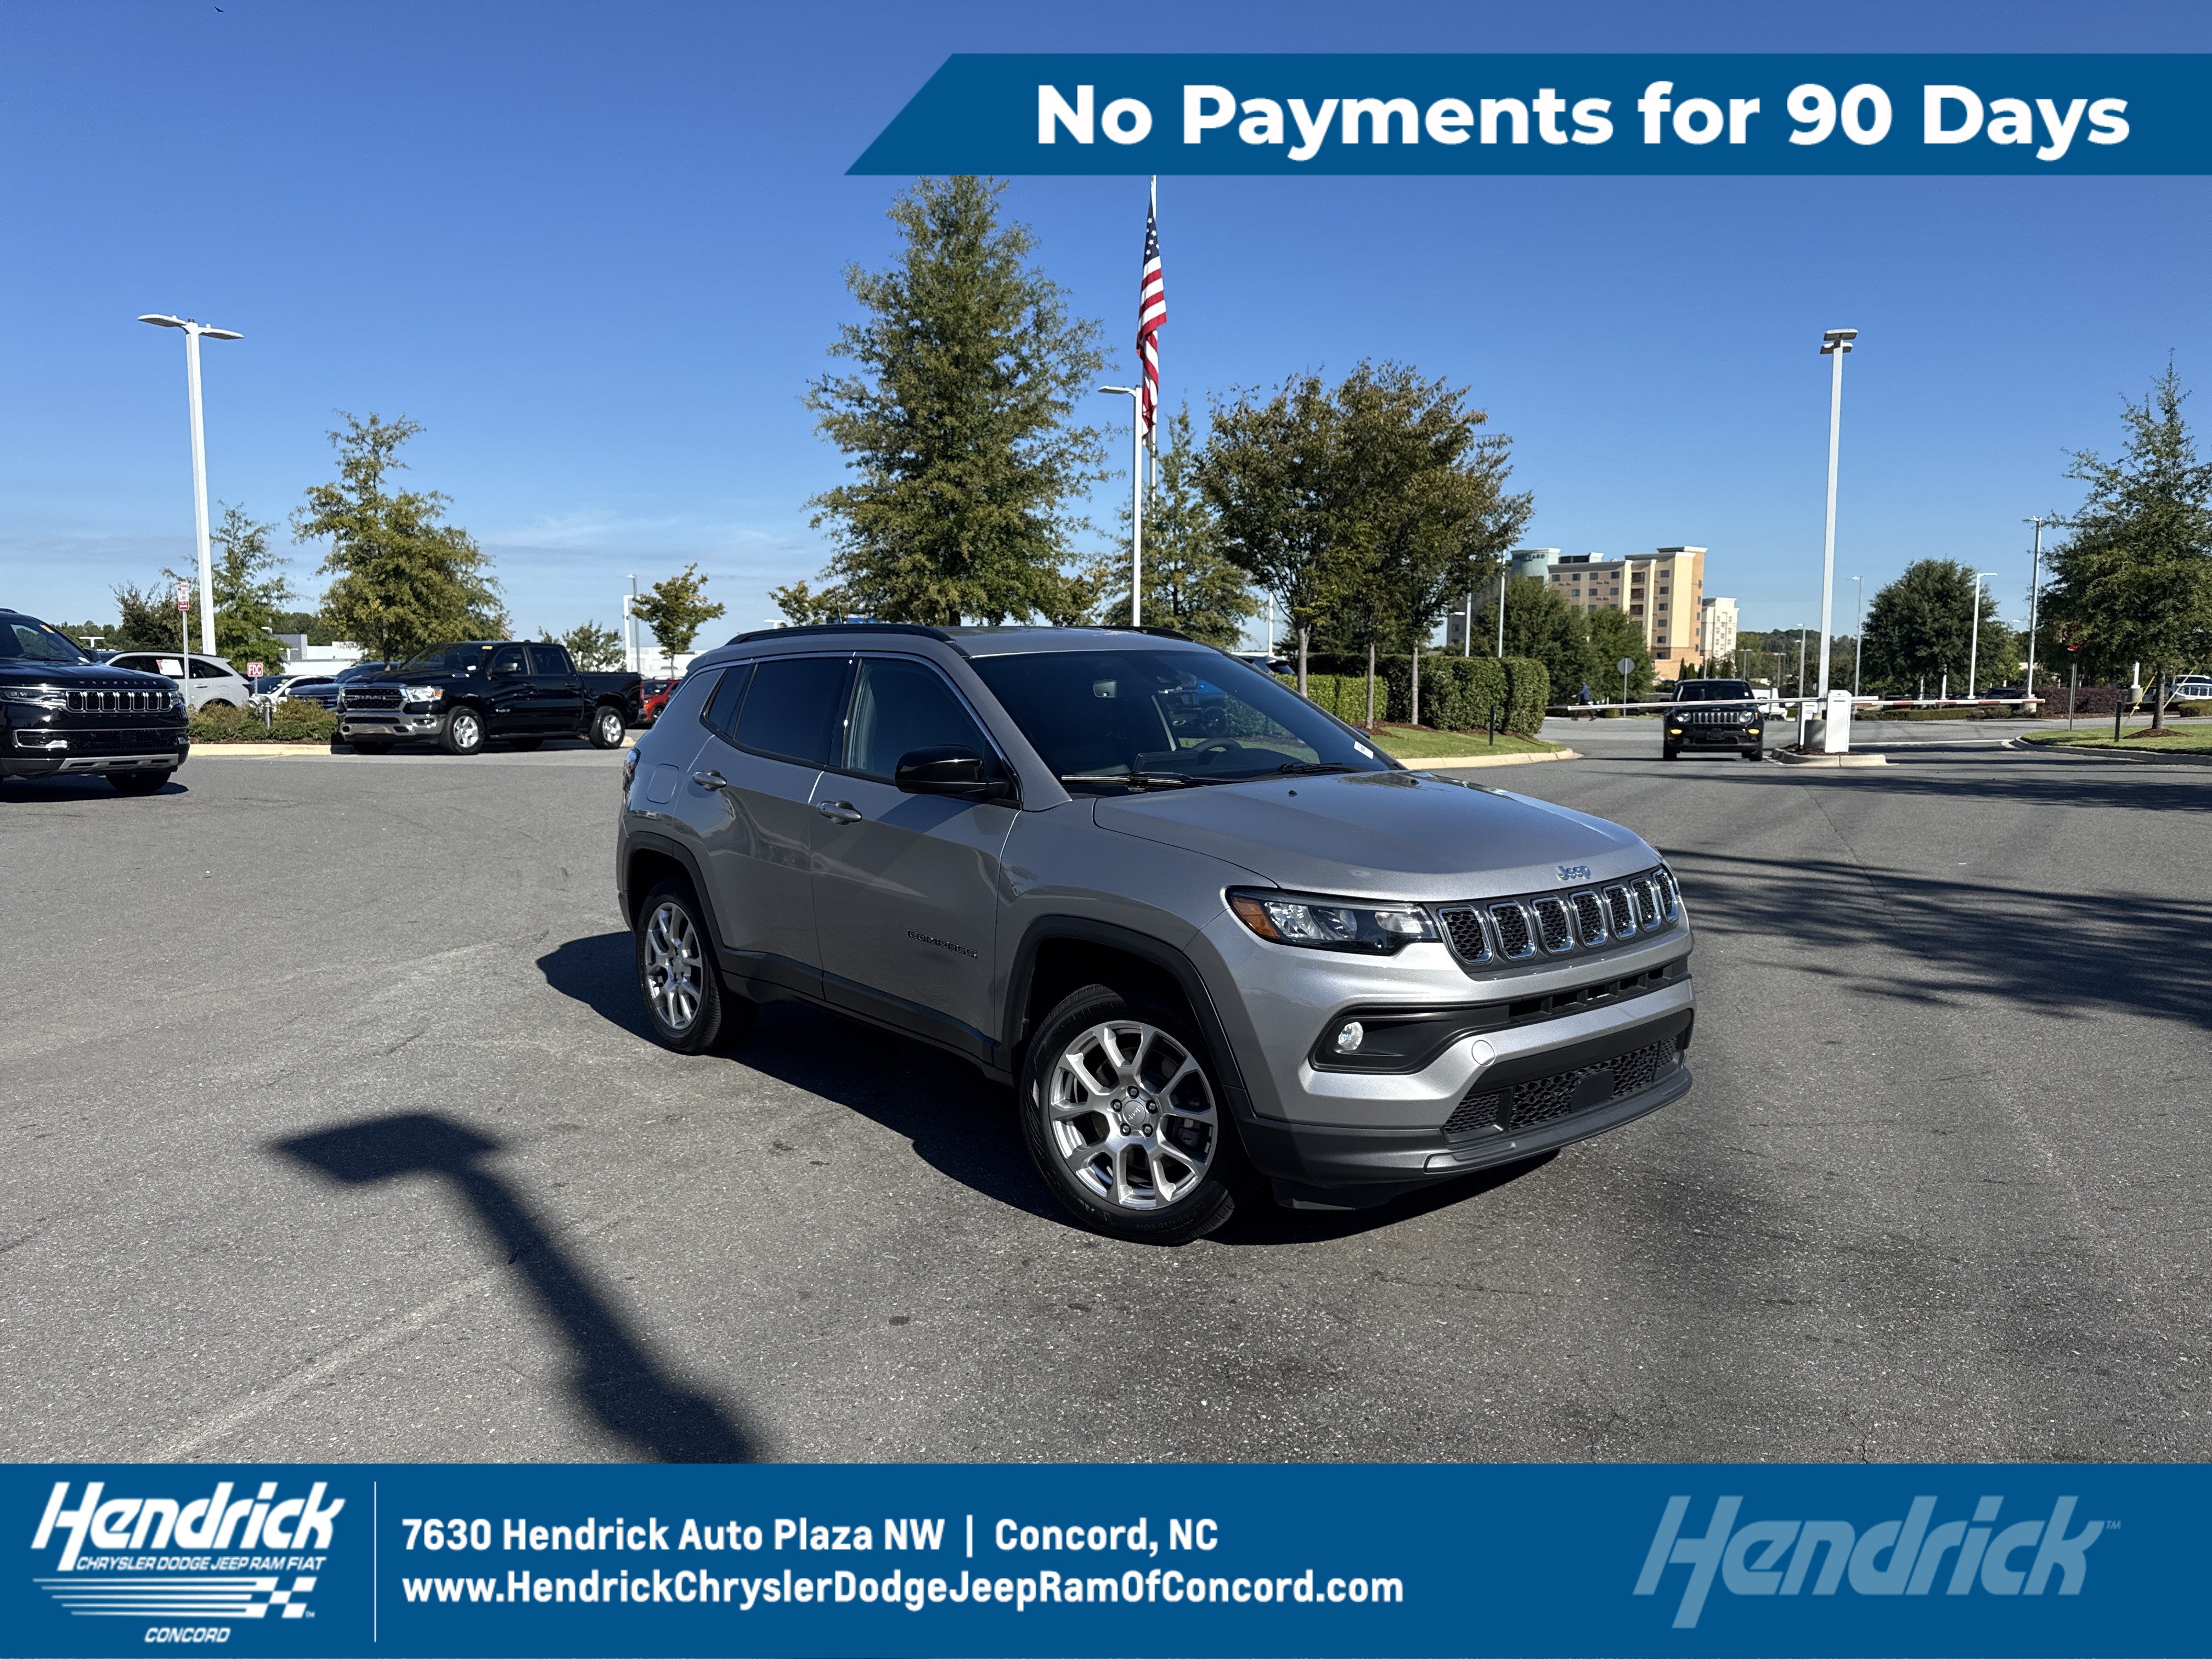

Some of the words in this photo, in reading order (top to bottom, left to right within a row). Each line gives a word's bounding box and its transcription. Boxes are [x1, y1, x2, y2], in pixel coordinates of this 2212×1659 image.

[249, 664, 262, 675] FDC
[1558, 865, 1592, 881] Jeep
[907, 929, 978, 960] COMPASS
